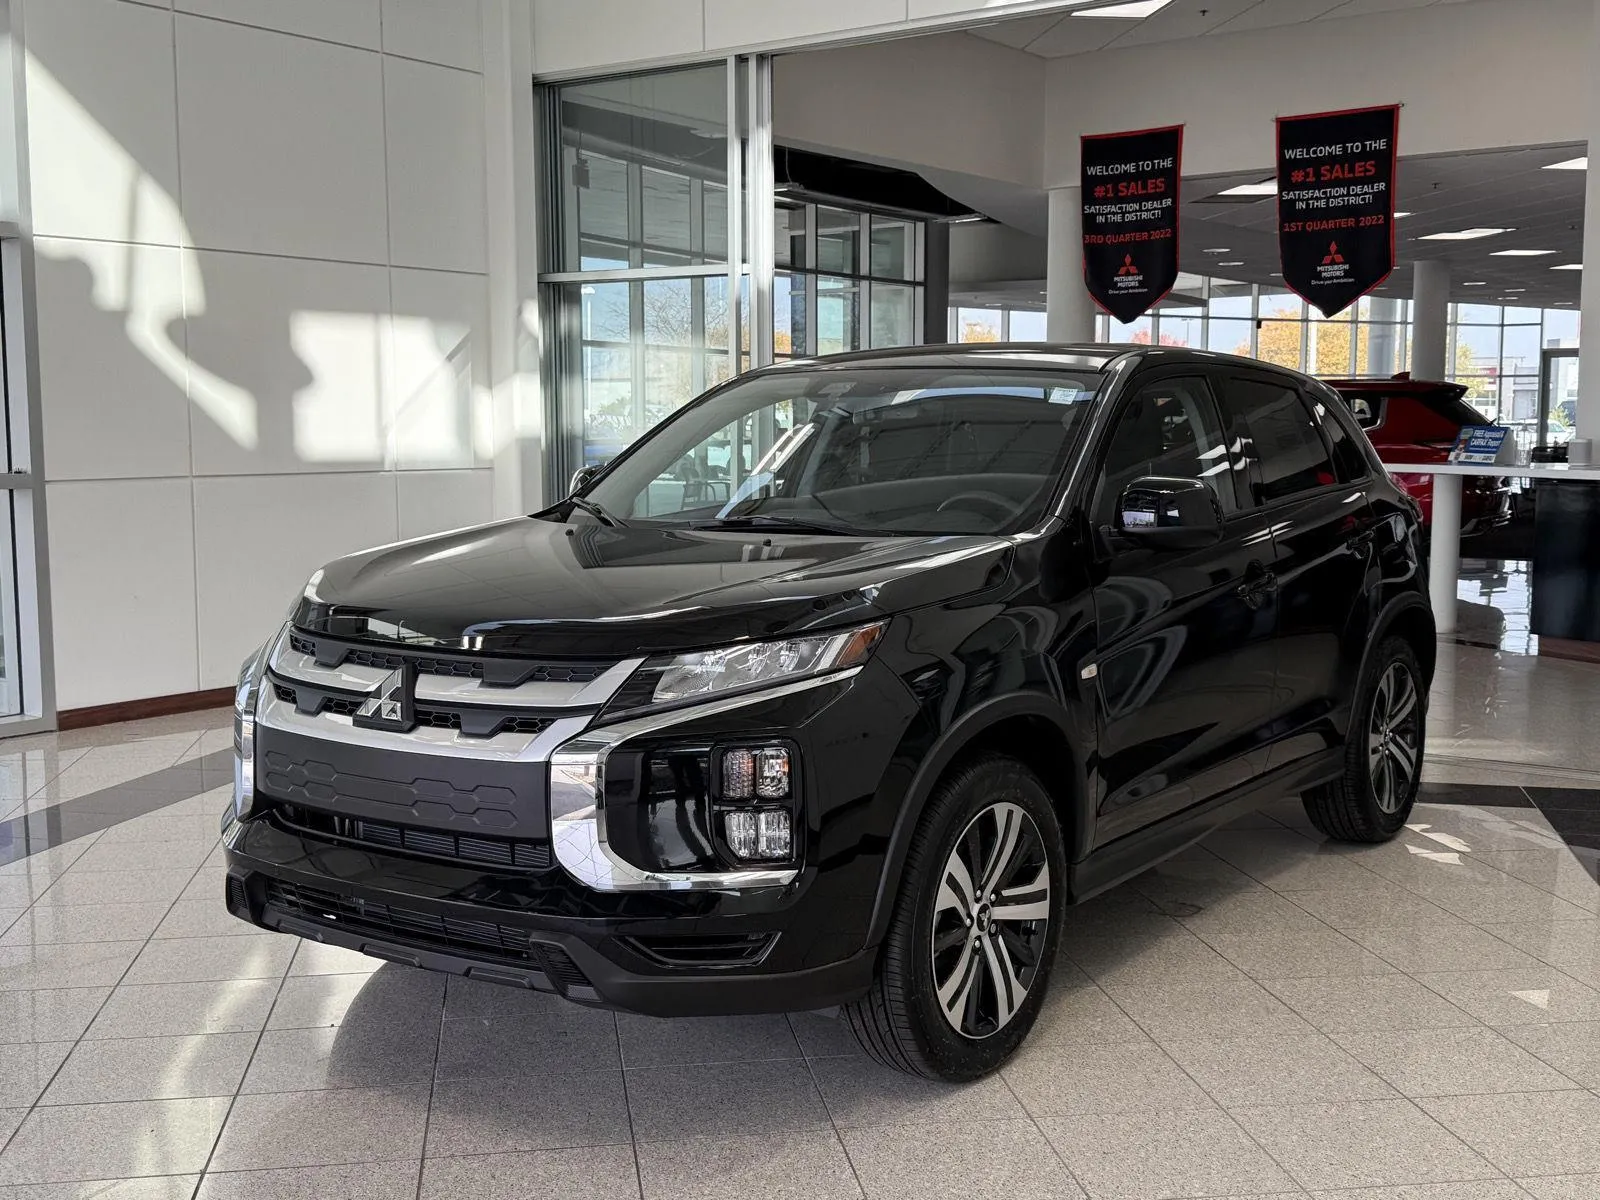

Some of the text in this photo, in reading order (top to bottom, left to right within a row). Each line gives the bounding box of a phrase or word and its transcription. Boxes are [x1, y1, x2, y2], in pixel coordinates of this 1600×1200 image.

[1284, 139, 1388, 160] WELCOME TO THE
[1086, 158, 1173, 176] WELCOME TO THE
[1291, 160, 1376, 183] #1 SALES
[1093, 178, 1165, 197] #1 SALES
[1282, 182, 1386, 200] SATISFACTION DEALER
[1084, 198, 1172, 214] SATISFACTION DEALER
[1296, 195, 1373, 210] IN THE DISTRICT!
[1096, 210, 1162, 223] IN THE DISTRICT!
[1284, 215, 1384, 232] 1ST QUARTER 2022
[1084, 228, 1172, 244] 3RD QUARTER 2022
[1317, 264, 1350, 272] MITSUBISHI
